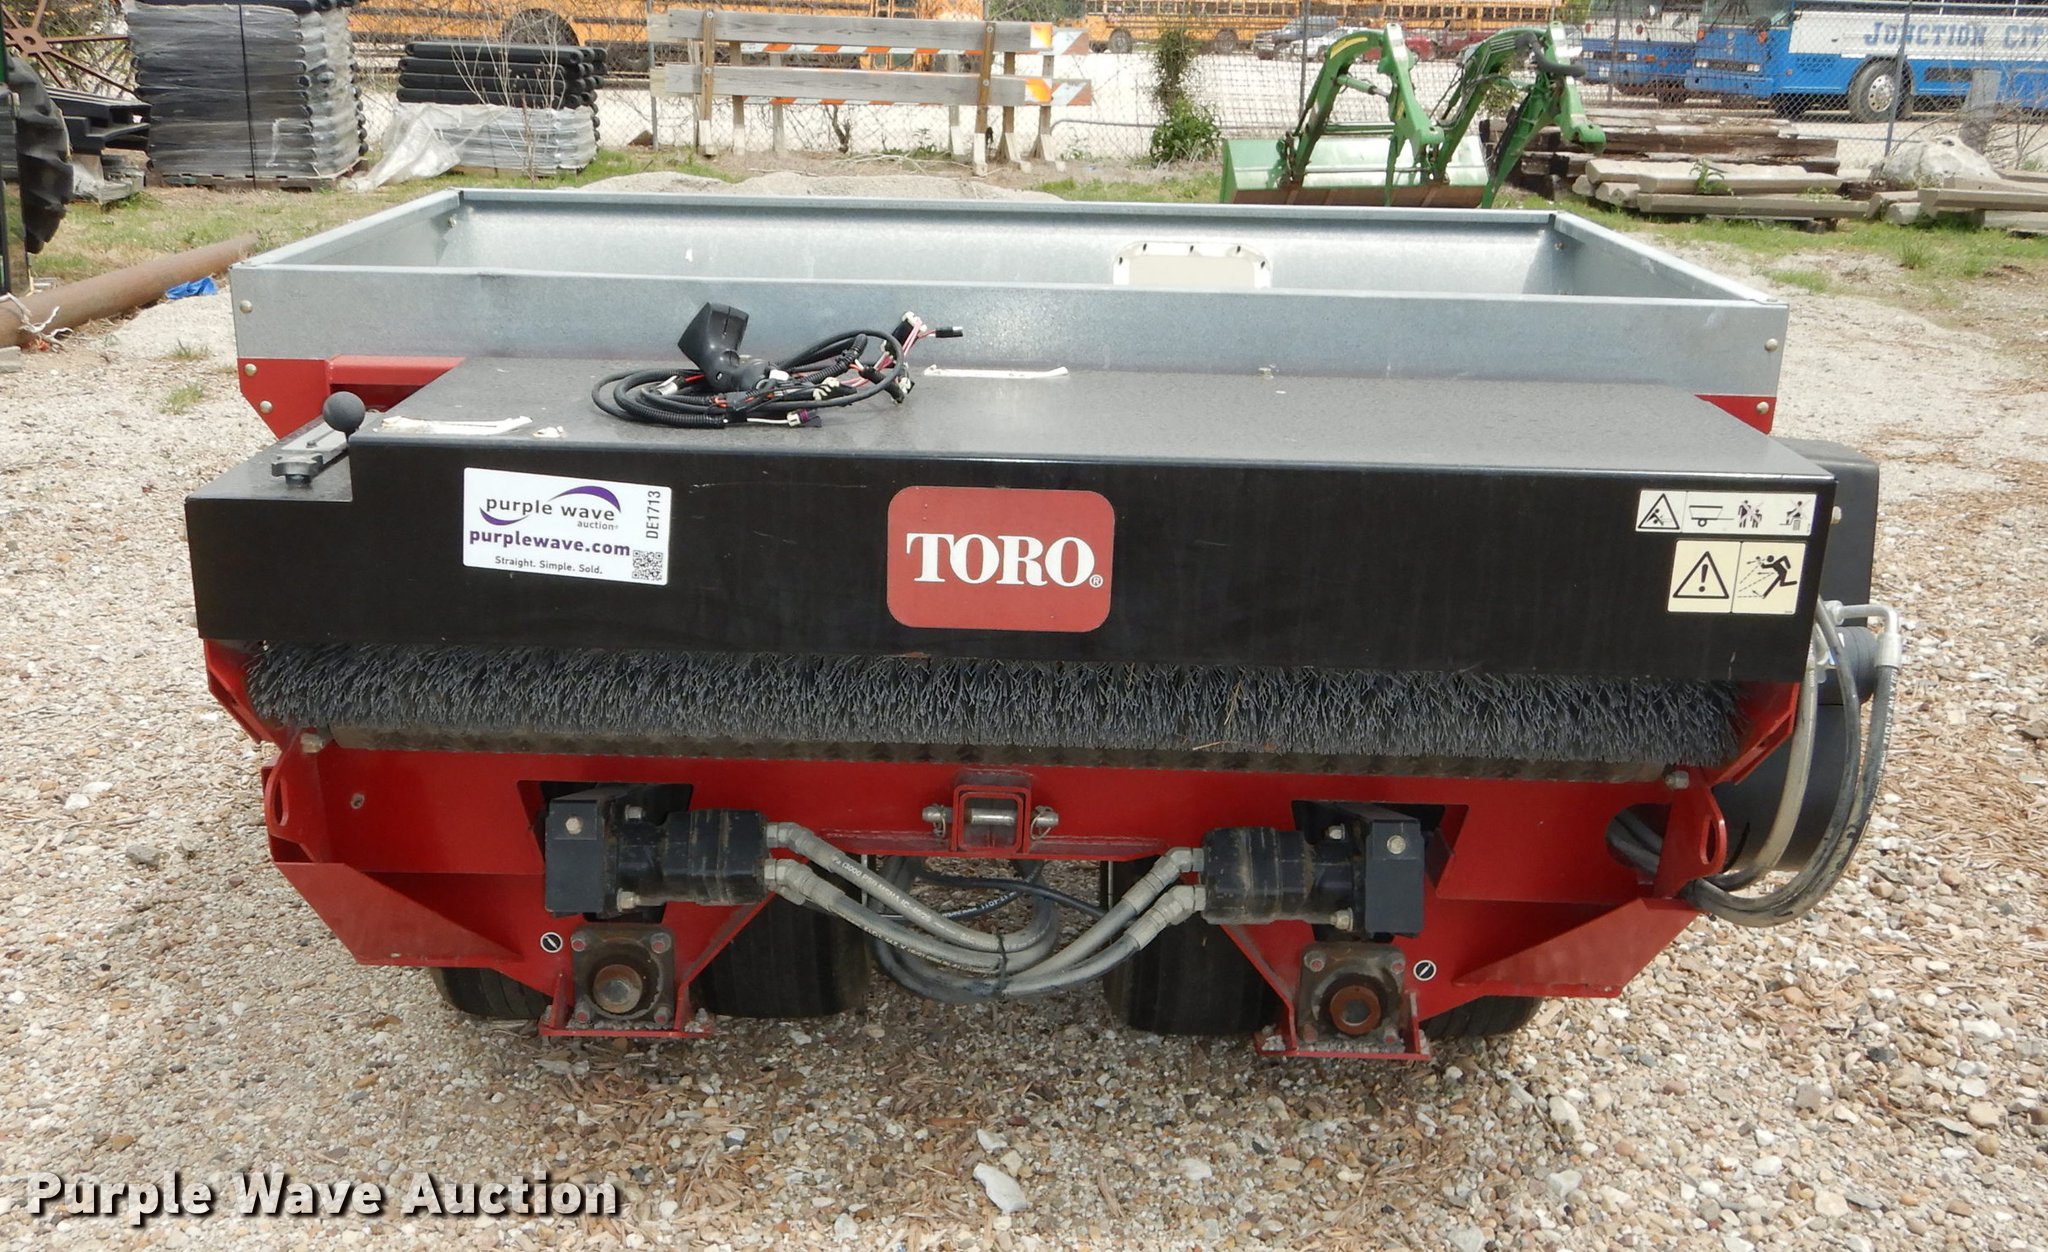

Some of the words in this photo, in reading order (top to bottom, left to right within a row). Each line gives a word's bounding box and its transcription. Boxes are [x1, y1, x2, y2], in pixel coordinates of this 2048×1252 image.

[1863, 21, 1987, 47] JUNCTION
[486, 497, 553, 516] purple
[561, 507, 616, 521] wave
[646, 490, 661, 540] DE1713
[577, 520, 615, 531] auction
[469, 530, 631, 557] purplewave.com
[495, 555, 536, 569] Straight.
[539, 560, 576, 573] Simple.
[579, 563, 603, 575] Sold.
[906, 532, 1095, 587] TORO
